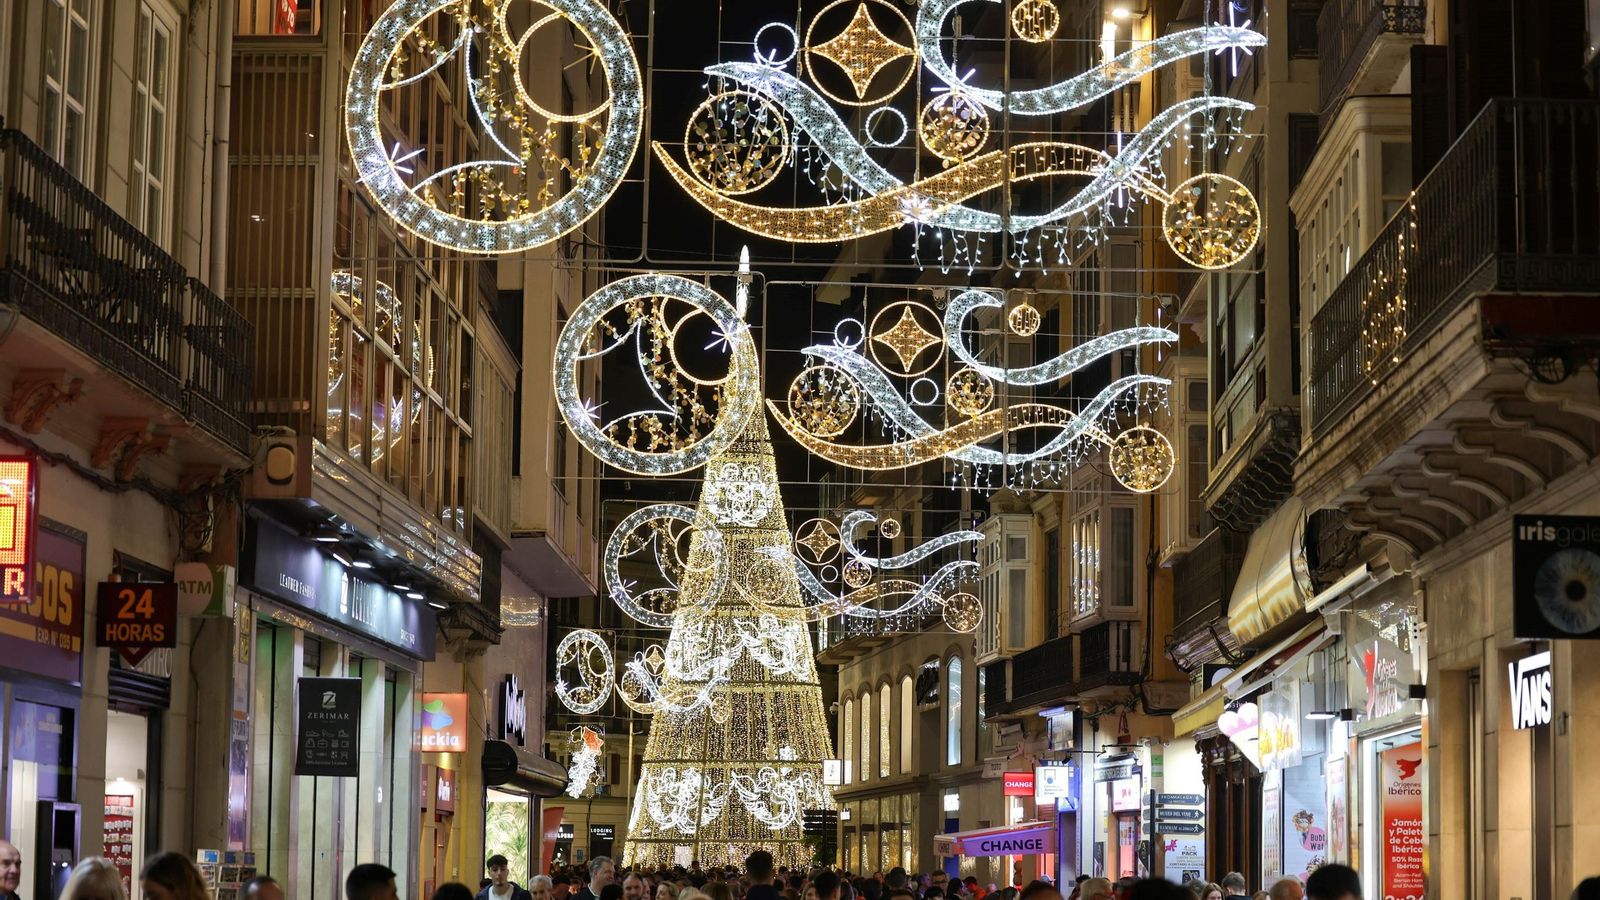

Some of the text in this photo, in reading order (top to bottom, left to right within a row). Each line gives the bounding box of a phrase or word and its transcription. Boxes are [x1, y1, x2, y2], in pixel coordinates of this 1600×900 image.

[179, 580, 211, 595] ATM
[118, 588, 155, 620] 24
[106, 623, 165, 643] HORAS
[1508, 651, 1551, 731] VANS
[307, 712, 350, 720] ZERIMAR
[981, 839, 1043, 852] CHANGE
[1390, 836, 1401, 845] de
[1392, 845, 1423, 854] Ibérico
